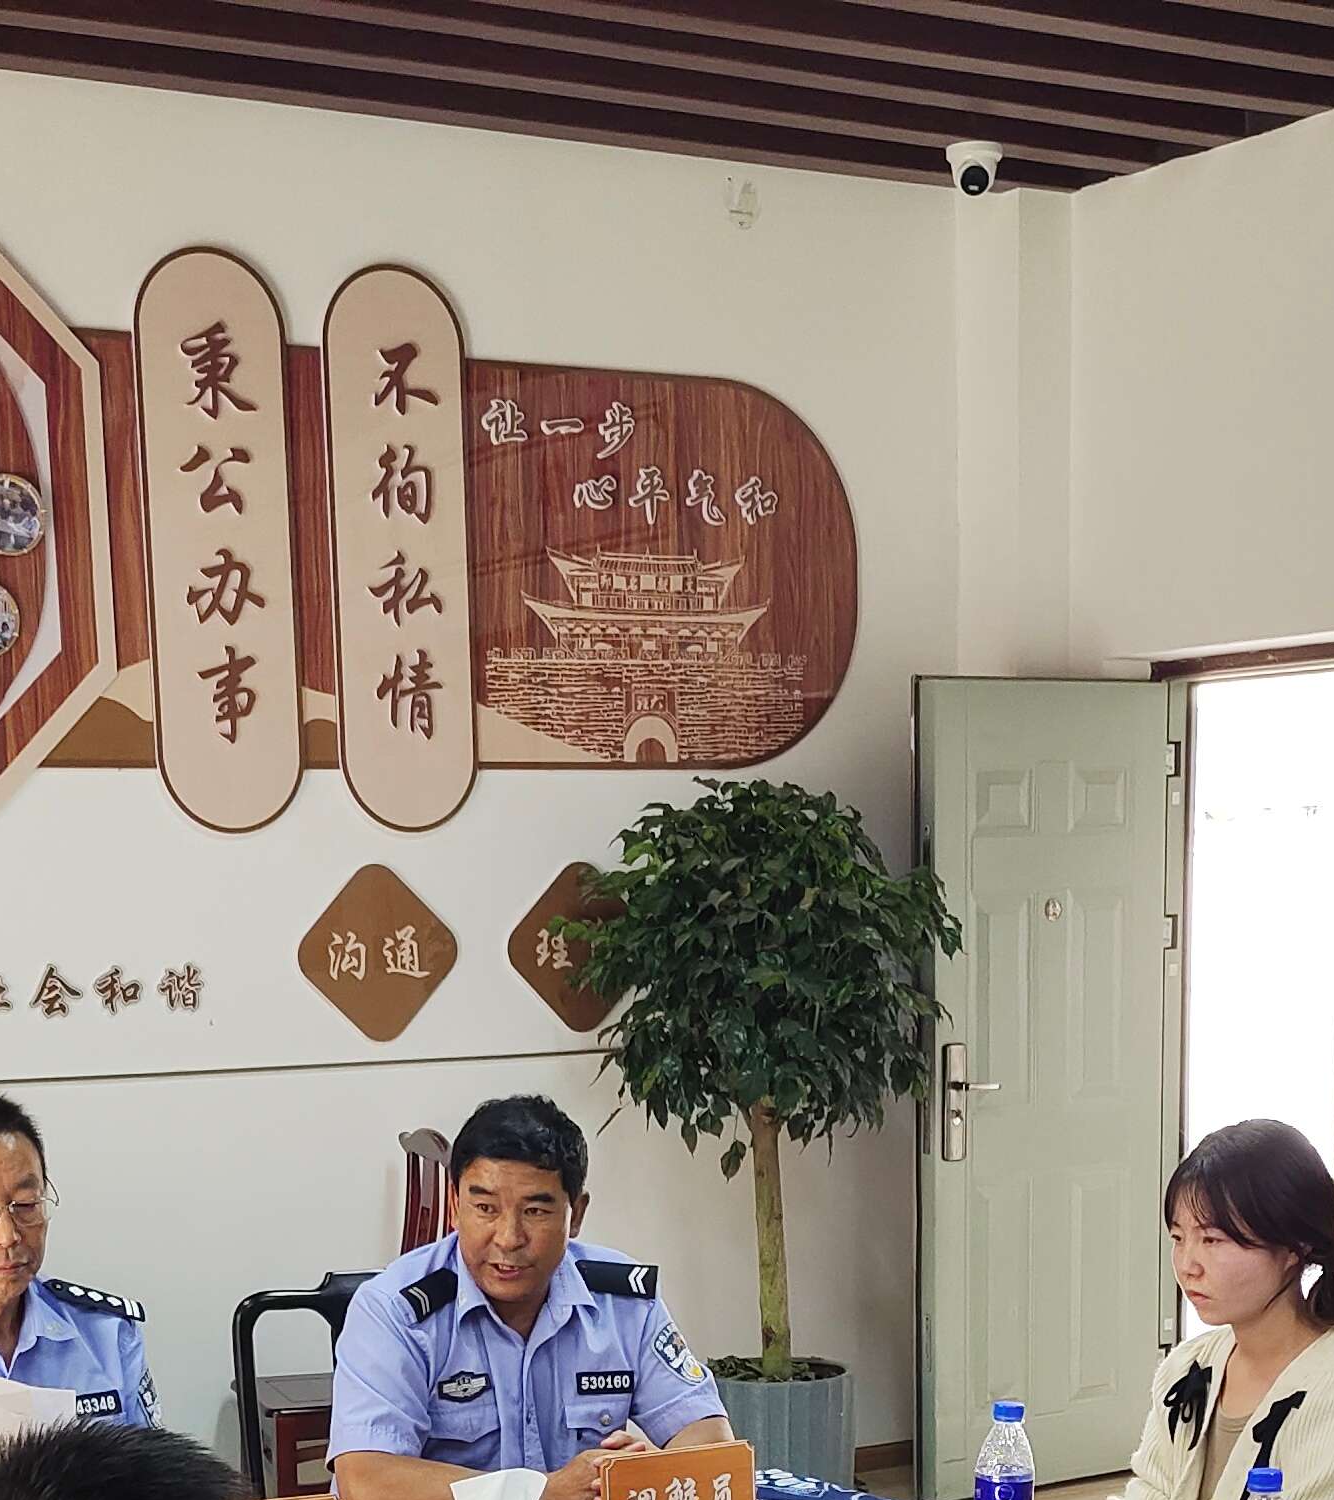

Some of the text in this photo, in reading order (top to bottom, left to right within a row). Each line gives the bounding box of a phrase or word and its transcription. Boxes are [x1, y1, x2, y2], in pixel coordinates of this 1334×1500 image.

[480, 398, 637, 460] 让一步
[573, 469, 780, 527] 心平气和
[178, 320, 266, 745] 秉公办事
[366, 341, 444, 745] 不徇私情
[324, 924, 432, 983] 沟通
[76, 1395, 116, 1415] 43348
[580, 1373, 631, 1392] 530160
